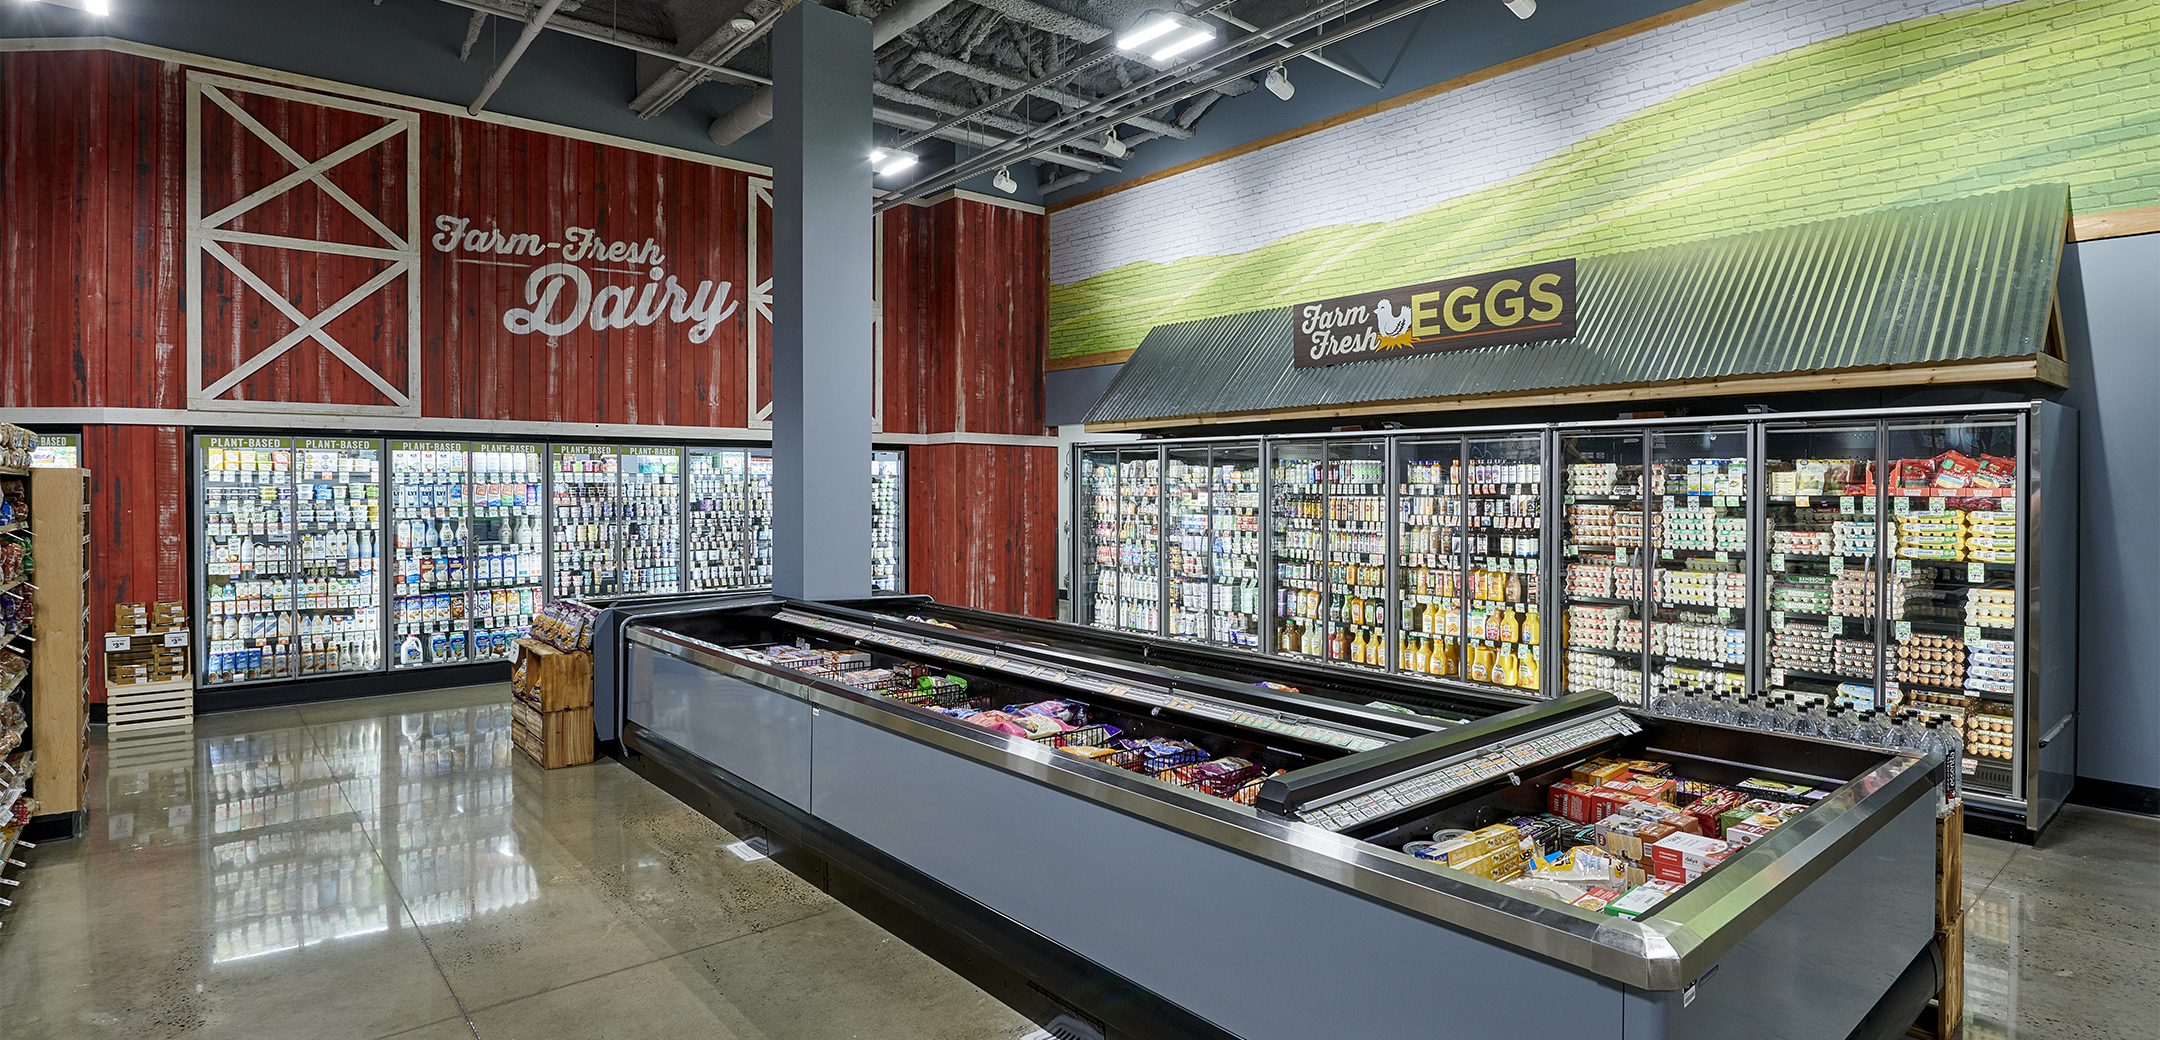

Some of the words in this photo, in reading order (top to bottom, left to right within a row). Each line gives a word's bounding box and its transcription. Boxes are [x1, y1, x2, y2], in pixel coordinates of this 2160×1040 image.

[432, 213, 665, 266] Farm-Fresh
[502, 262, 739, 344] Dairy
[1411, 272, 1563, 337] EGGS
[1301, 303, 1370, 335] Farm
[1309, 326, 1381, 360] Fresh
[211, 438, 281, 448] PLANT-BASED
[306, 439, 370, 449] PLANT-BASED
[403, 442, 462, 451] PLANT-BASED
[481, 444, 535, 453] PLANT-BASED
[561, 445, 611, 454] PLANT-BASED
[630, 447, 676, 455] PLANT-BASED
